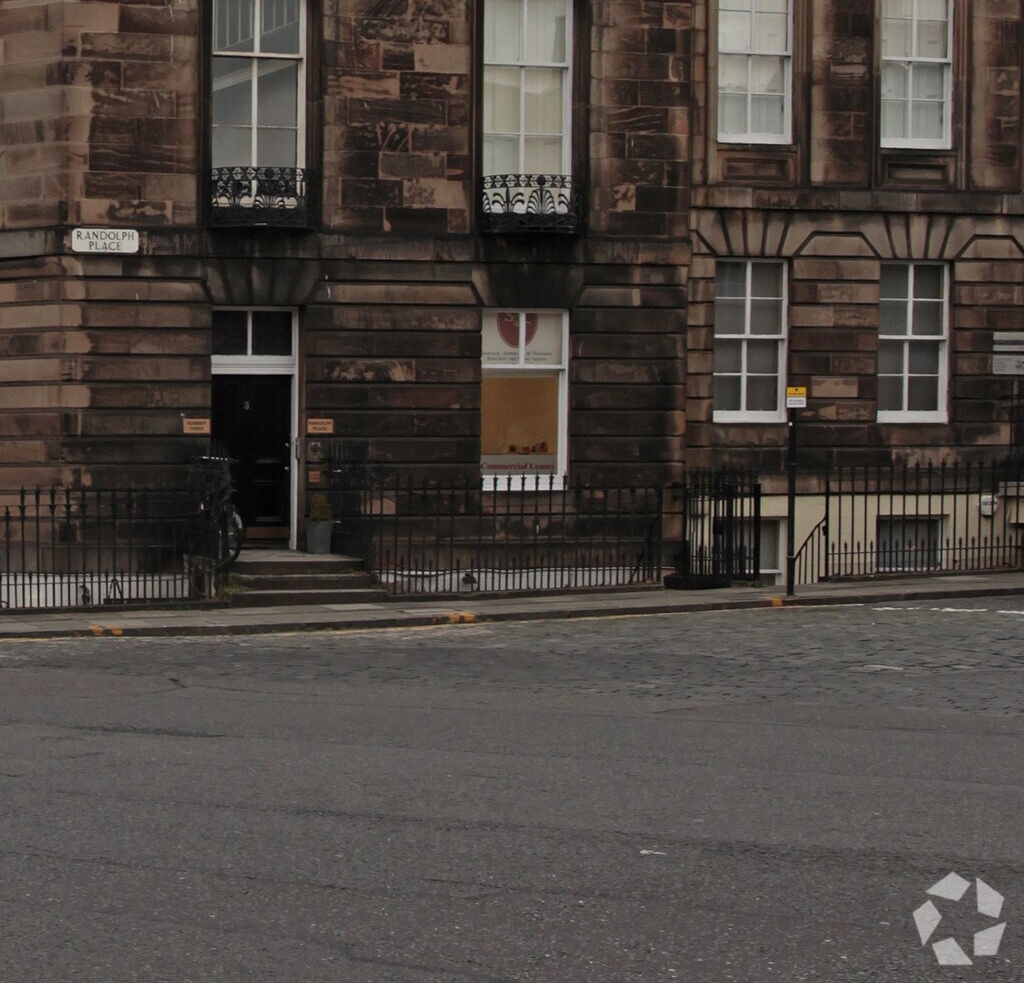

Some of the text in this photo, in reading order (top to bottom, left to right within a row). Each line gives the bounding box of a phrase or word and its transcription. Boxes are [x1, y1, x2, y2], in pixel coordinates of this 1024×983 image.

[76, 230, 134, 241] RANDOLPH
[88, 241, 122, 251] PLACE
[480, 462, 527, 470] Commercial
